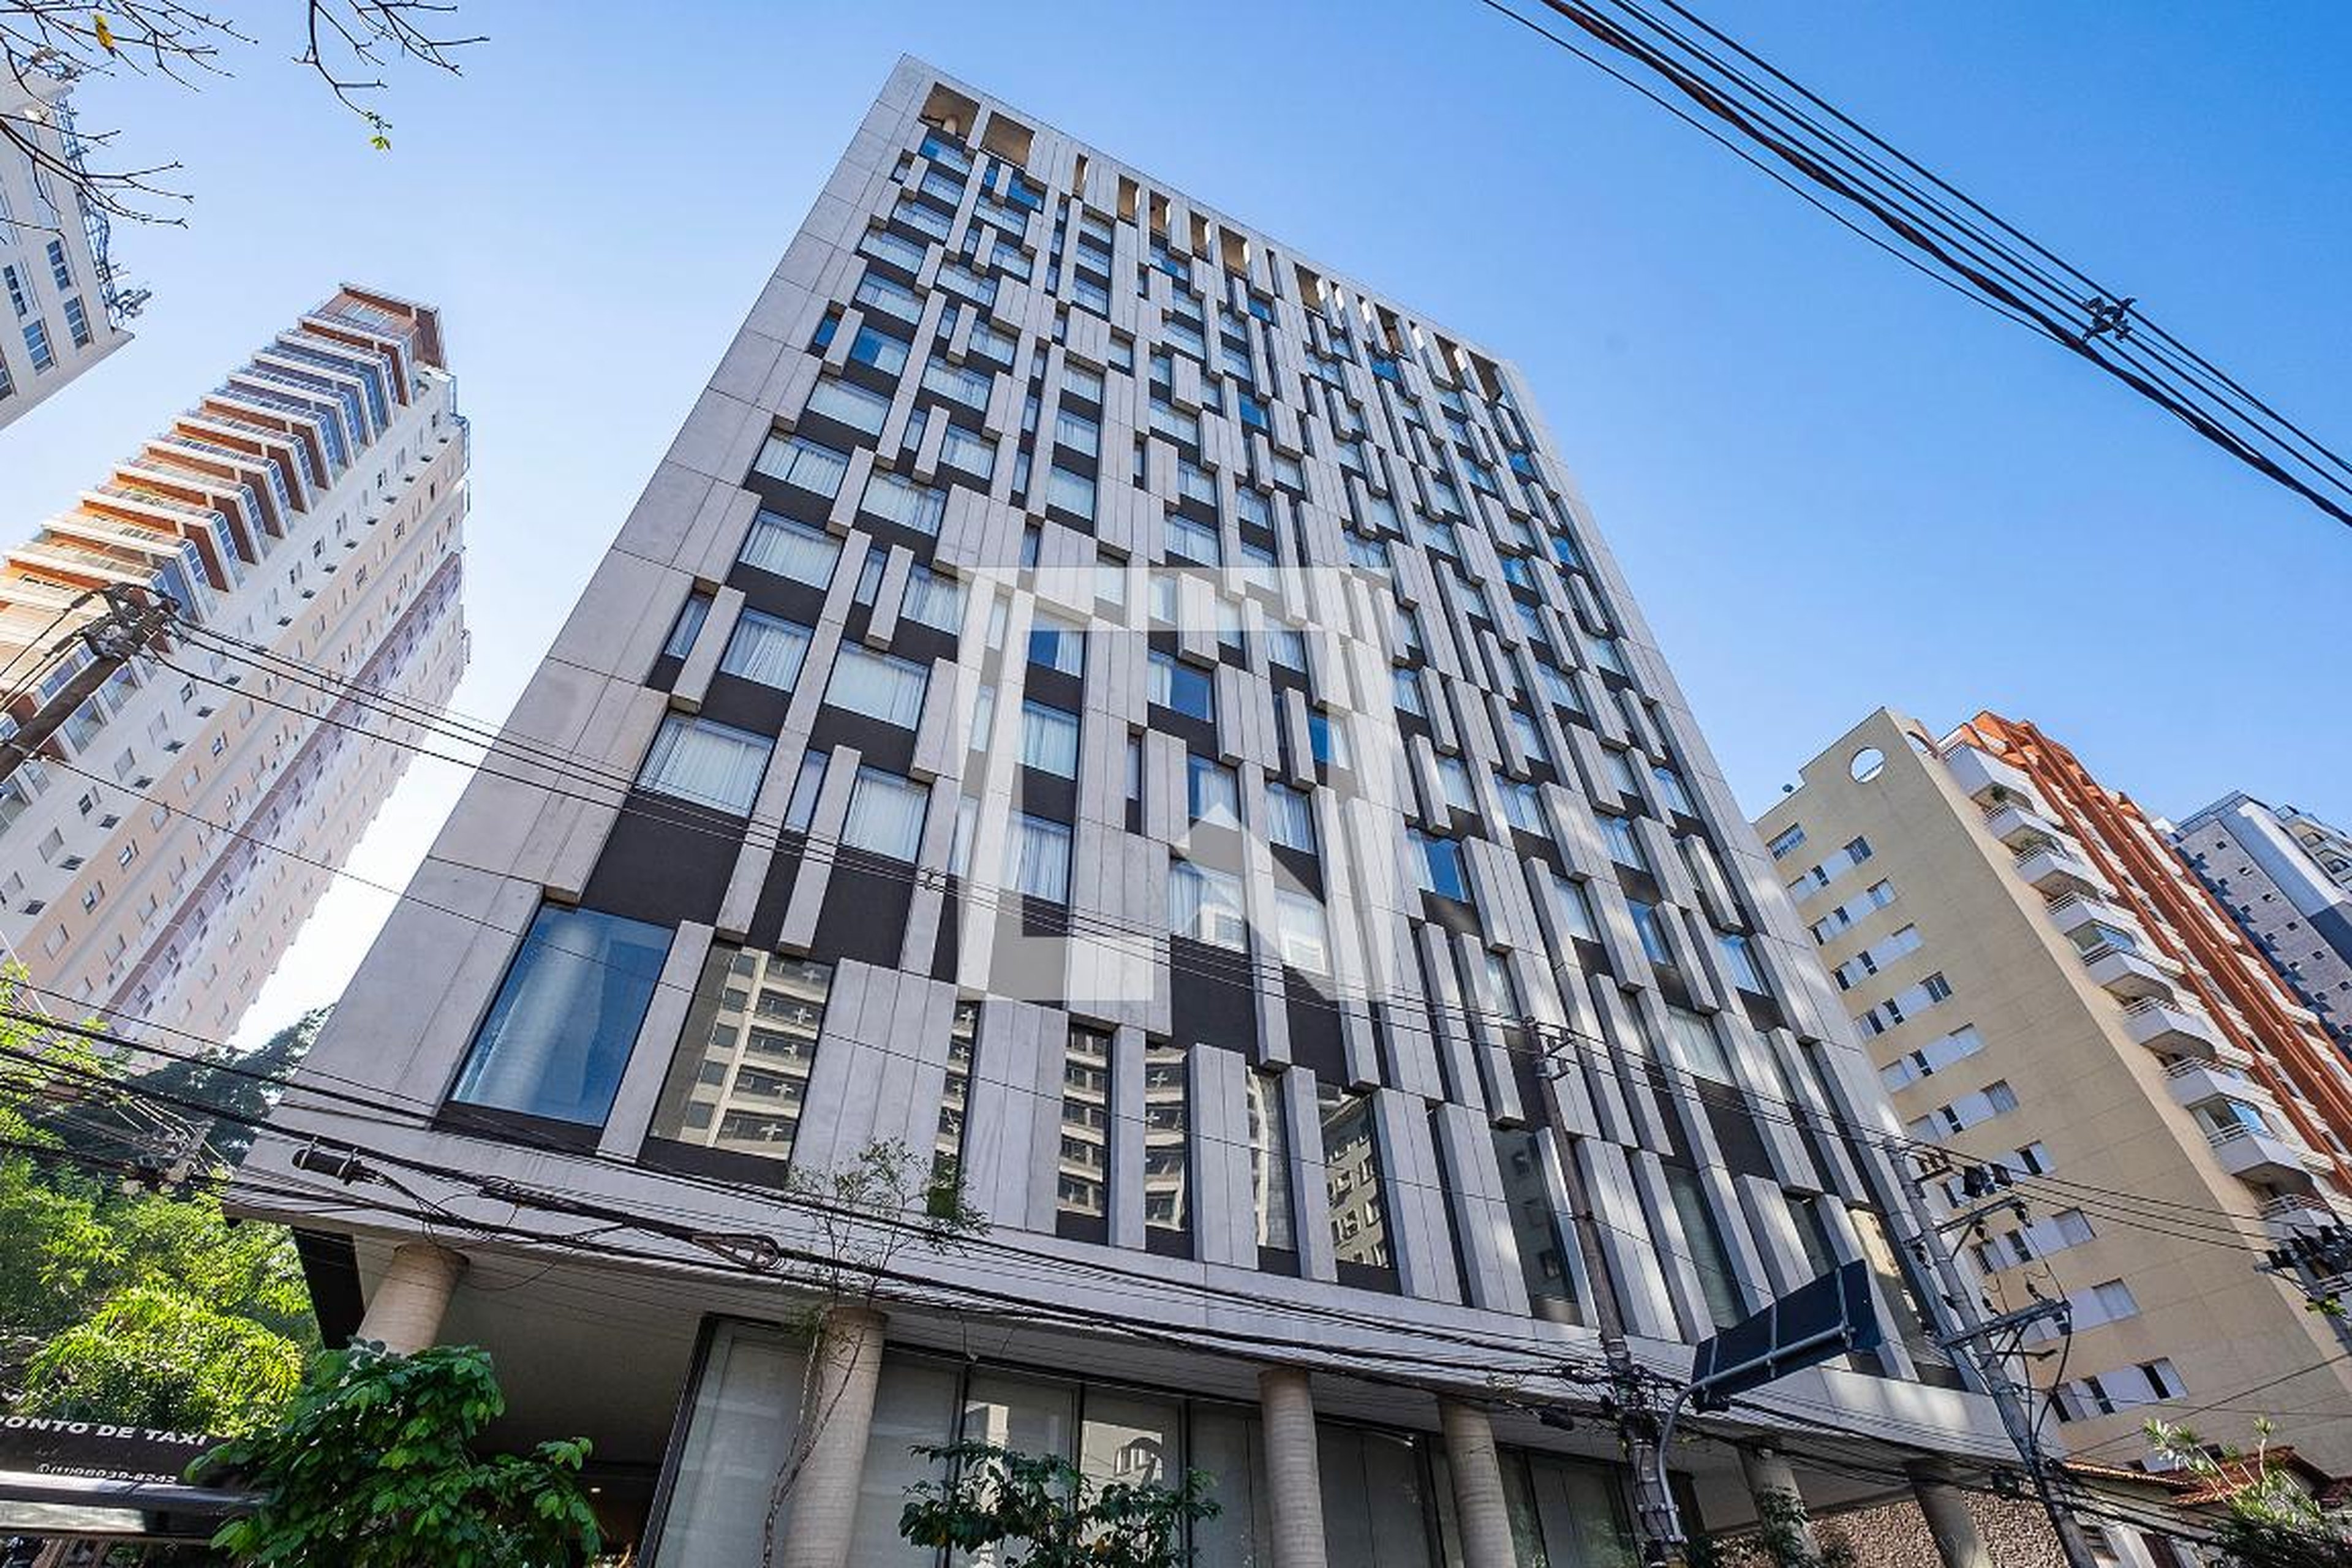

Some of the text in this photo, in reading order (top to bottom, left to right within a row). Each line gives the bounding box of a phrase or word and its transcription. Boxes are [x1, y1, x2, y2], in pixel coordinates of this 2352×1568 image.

[0, 1415, 207, 1447] ONTO DE TAXI
